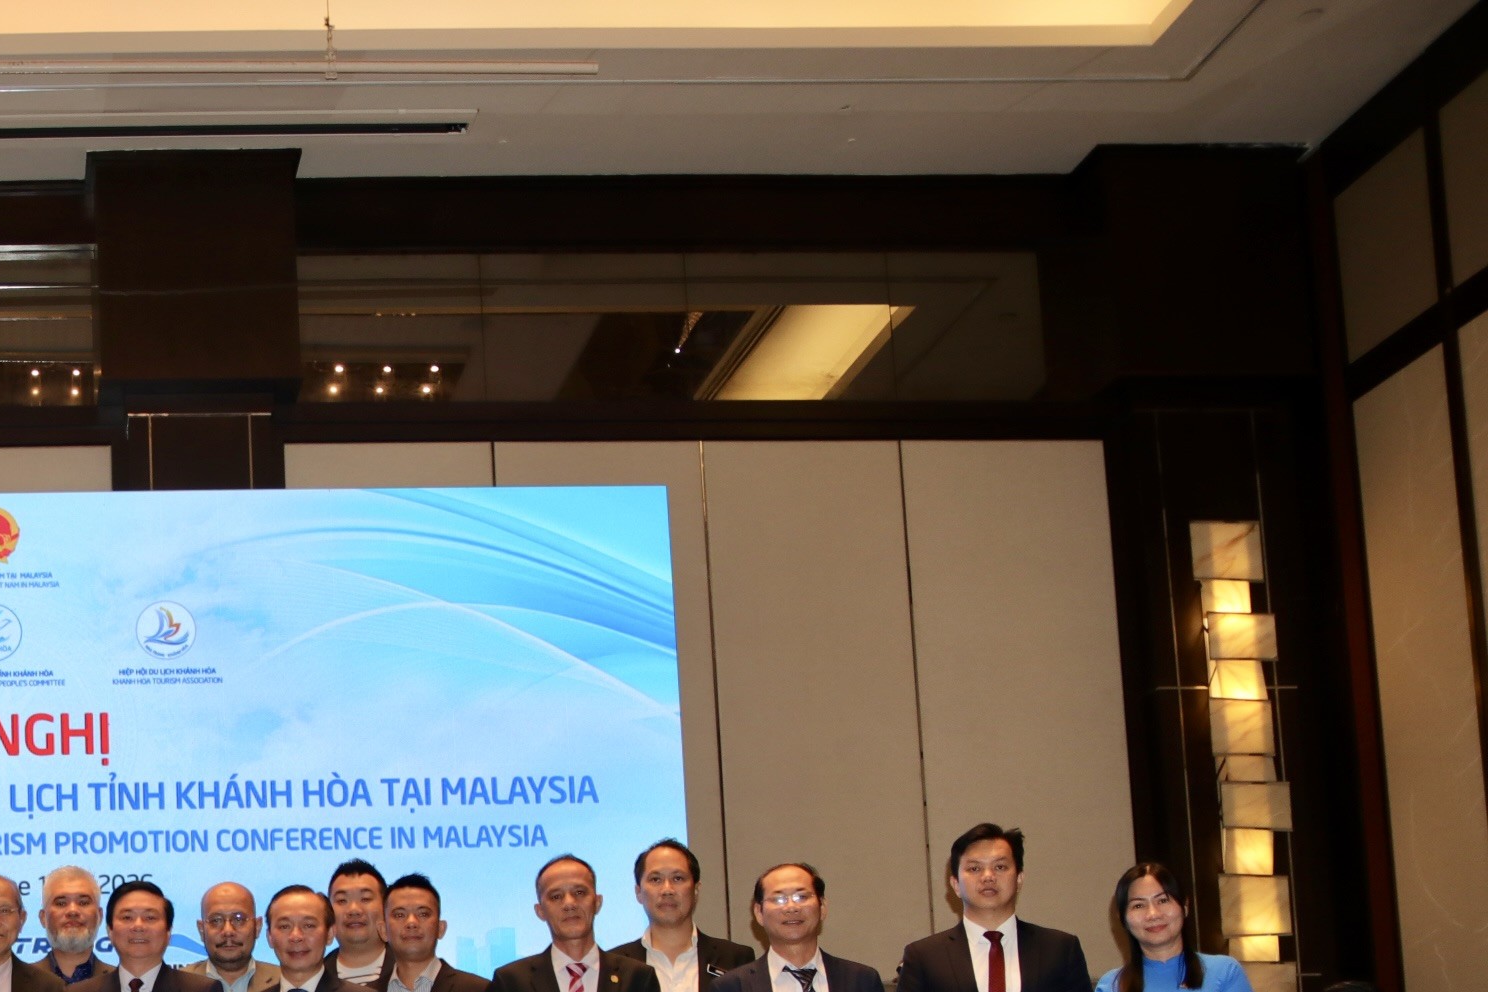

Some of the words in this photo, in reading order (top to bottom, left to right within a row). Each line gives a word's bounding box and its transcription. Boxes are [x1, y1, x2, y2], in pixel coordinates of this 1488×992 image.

[9, 782, 79, 820] LỊCH
[87, 771, 166, 811] TỈNH
[175, 773, 293, 810] KHÁNH
[302, 771, 373, 808] HÒA
[380, 777, 432, 814] TẠI
[441, 774, 600, 806] MALAYSIA
[54, 829, 209, 855] PROMOTION
[216, 826, 383, 852] CONFERENCE
[390, 826, 416, 850] IN
[422, 823, 549, 849] MALAYSIA
